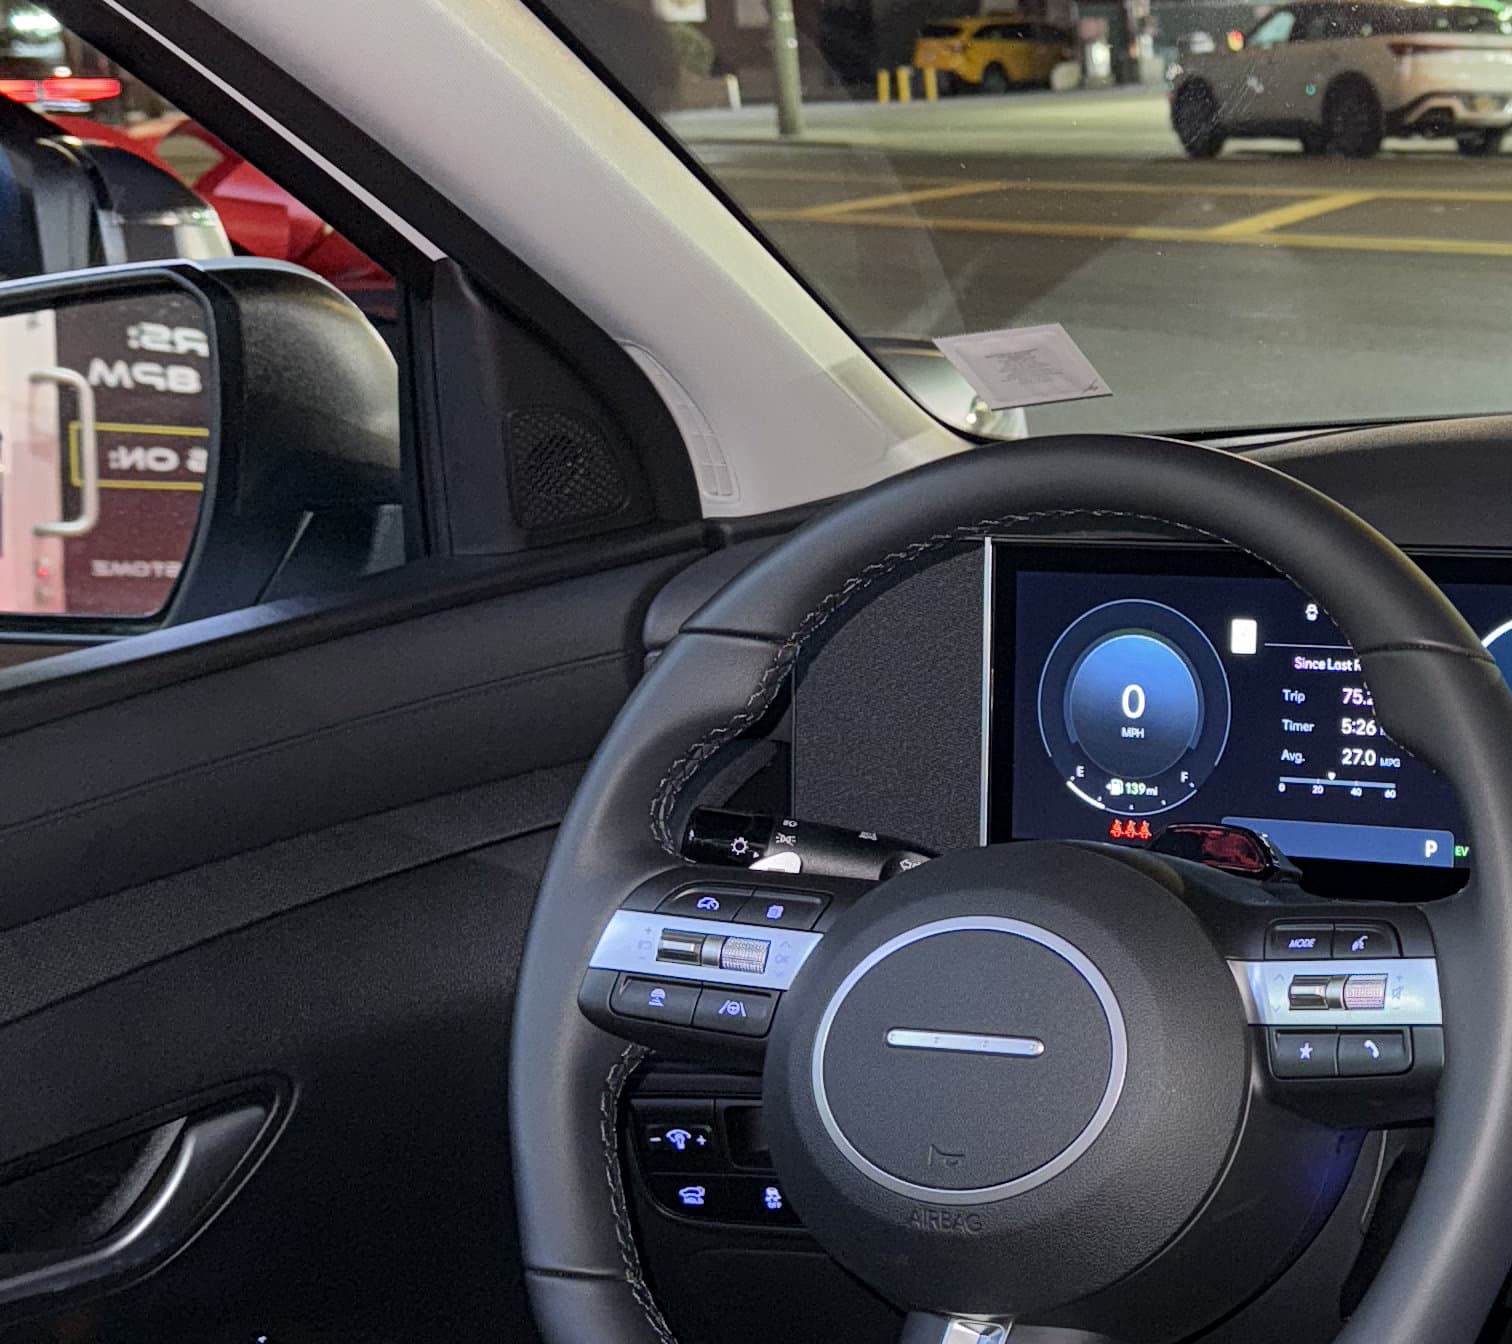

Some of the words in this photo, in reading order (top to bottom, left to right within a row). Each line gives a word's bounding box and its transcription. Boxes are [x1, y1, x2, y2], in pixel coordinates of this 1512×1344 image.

[1294, 656, 1325, 670] Since
[1327, 658, 1352, 671] Last
[1121, 683, 1146, 719] 0
[1282, 689, 1305, 704] Trip
[1121, 726, 1144, 739] MPH
[1281, 718, 1315, 732] Timer
[1341, 717, 1377, 736] 5:26
[1281, 748, 1305, 764] Avg.
[1341, 748, 1377, 766] 27.0
[1076, 765, 1085, 778] E
[1180, 771, 1188, 783] F
[1278, 783, 1286, 793] 0
[1311, 785, 1324, 795] 20
[1424, 840, 1438, 858] P
[1454, 845, 1469, 857] EV
[1288, 937, 1317, 949] MODE
[911, 1207, 983, 1235] AIRBAG
